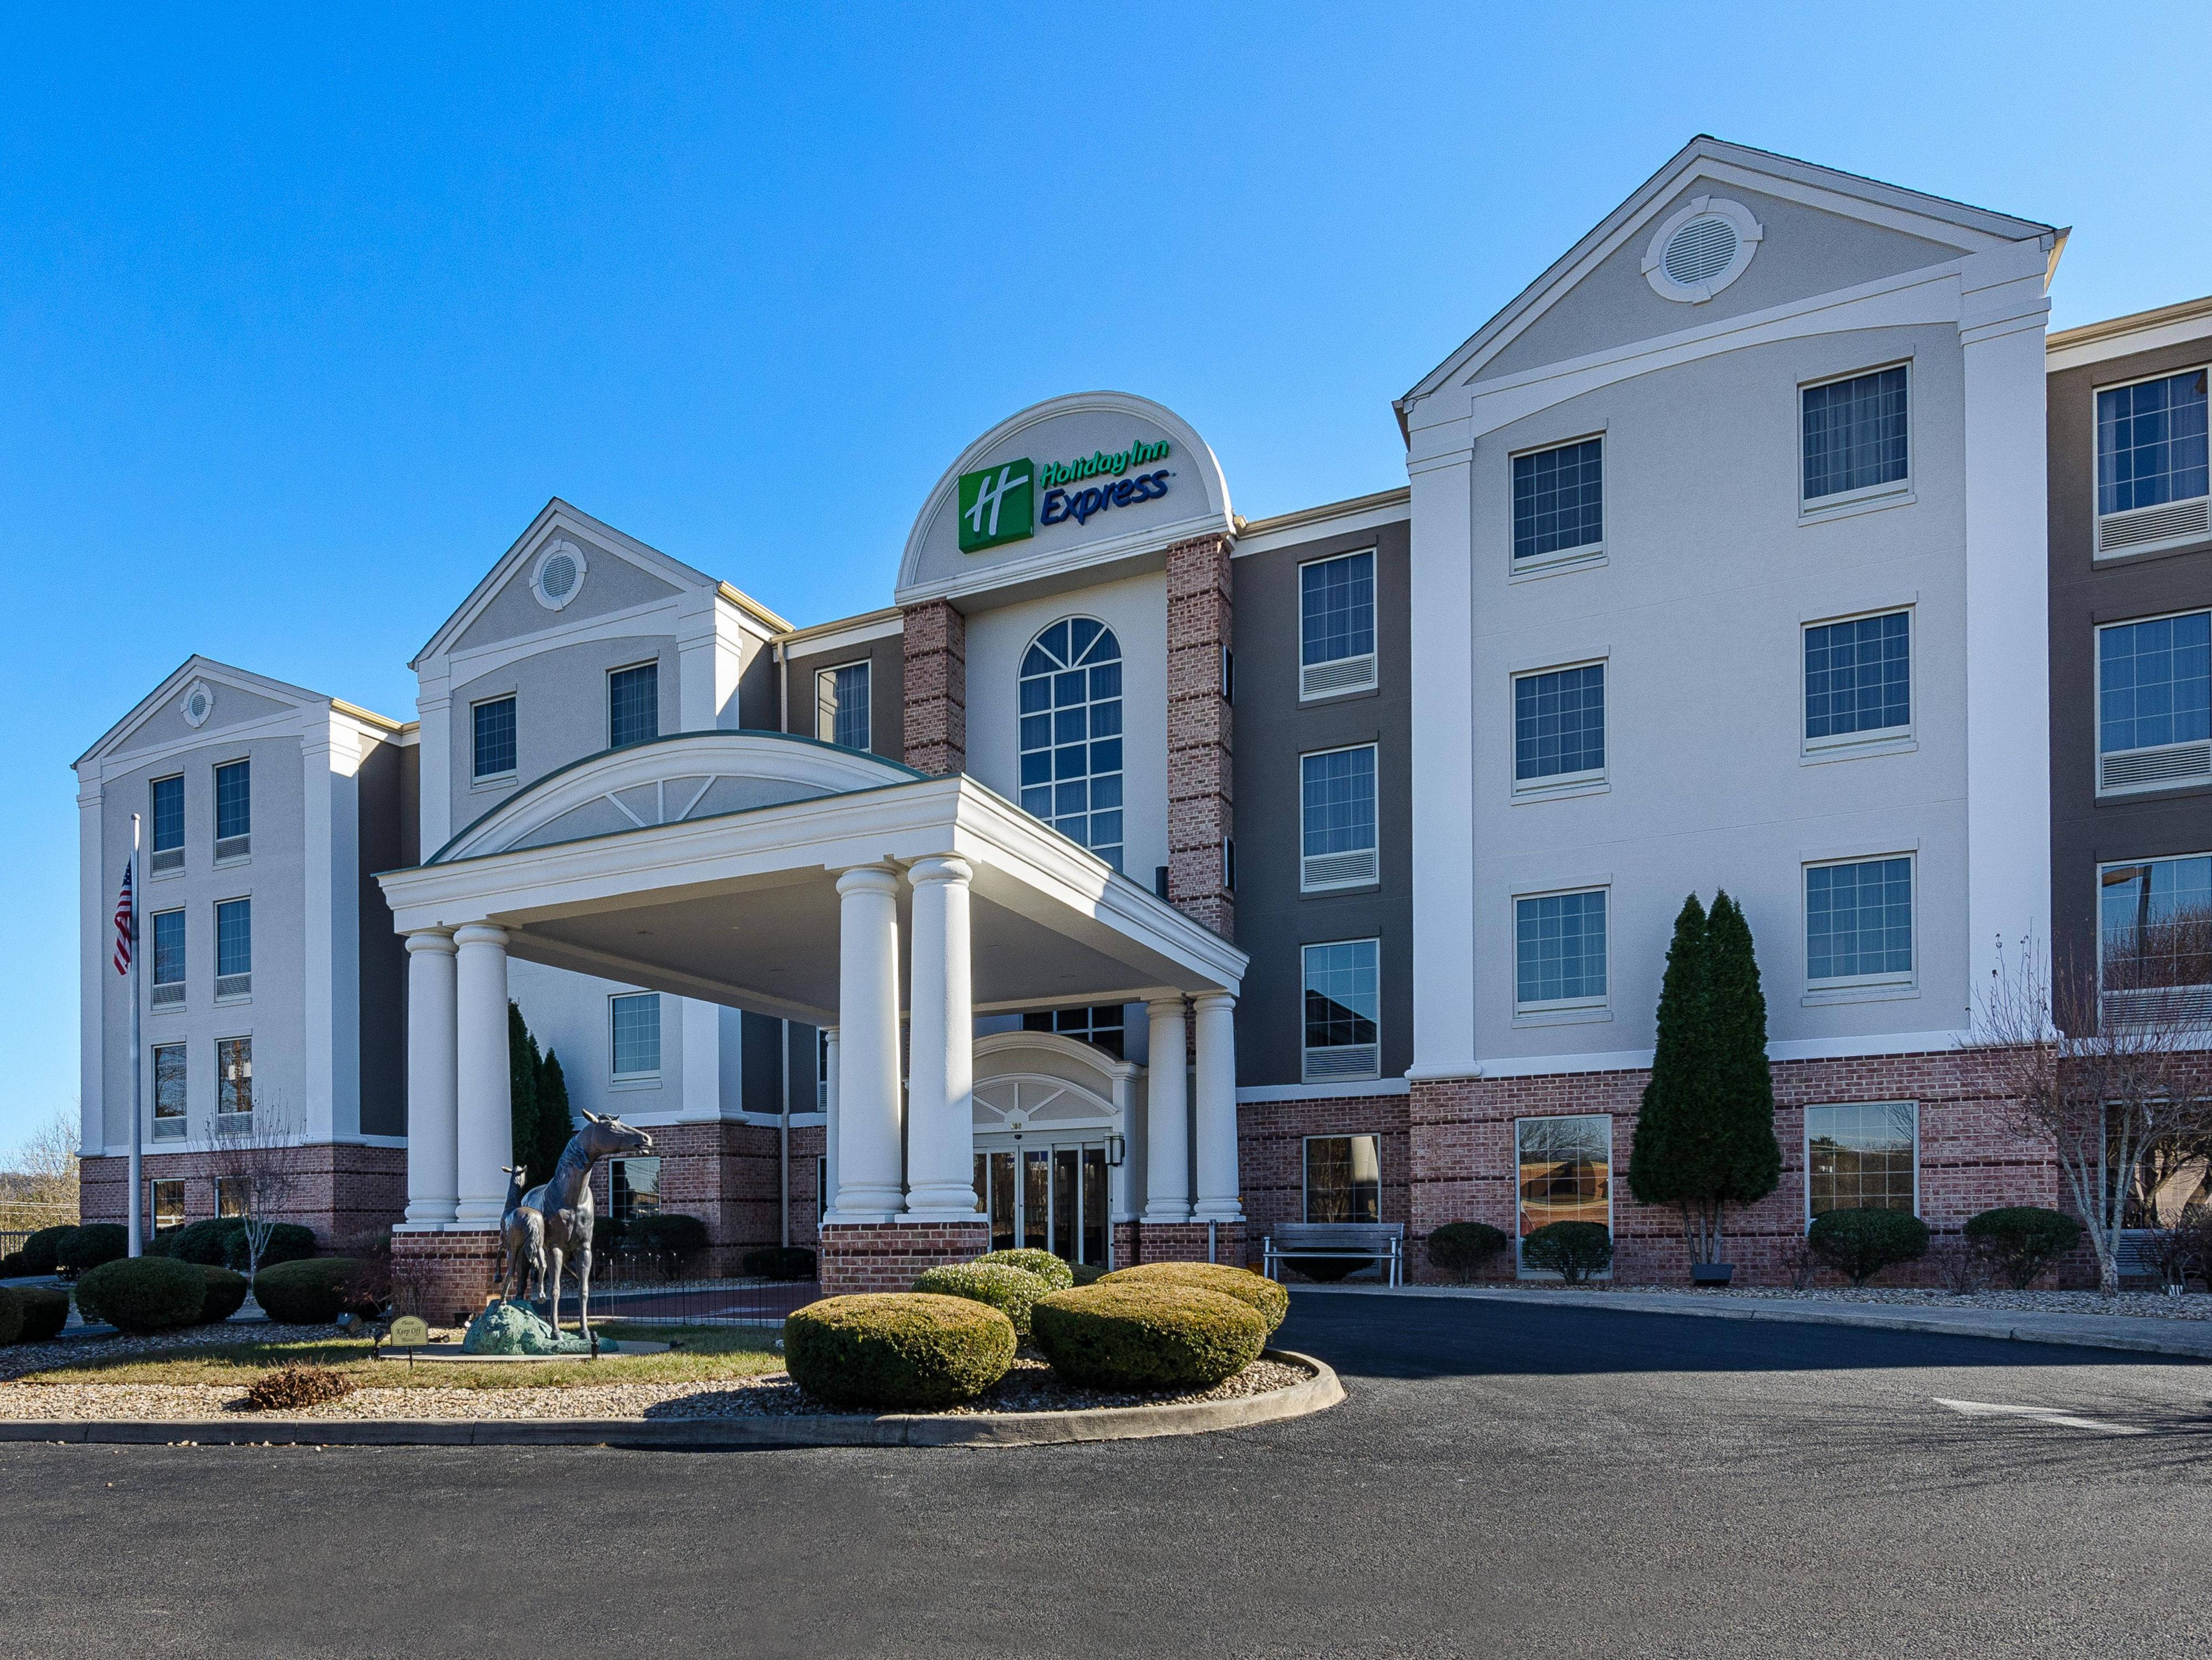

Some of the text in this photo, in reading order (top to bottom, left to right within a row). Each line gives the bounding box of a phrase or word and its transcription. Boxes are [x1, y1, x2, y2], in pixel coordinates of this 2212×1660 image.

[1040, 439, 1170, 490] Holiday Inn
[1041, 470, 1170, 525] Express
[396, 1326, 422, 1336] Keep Off
